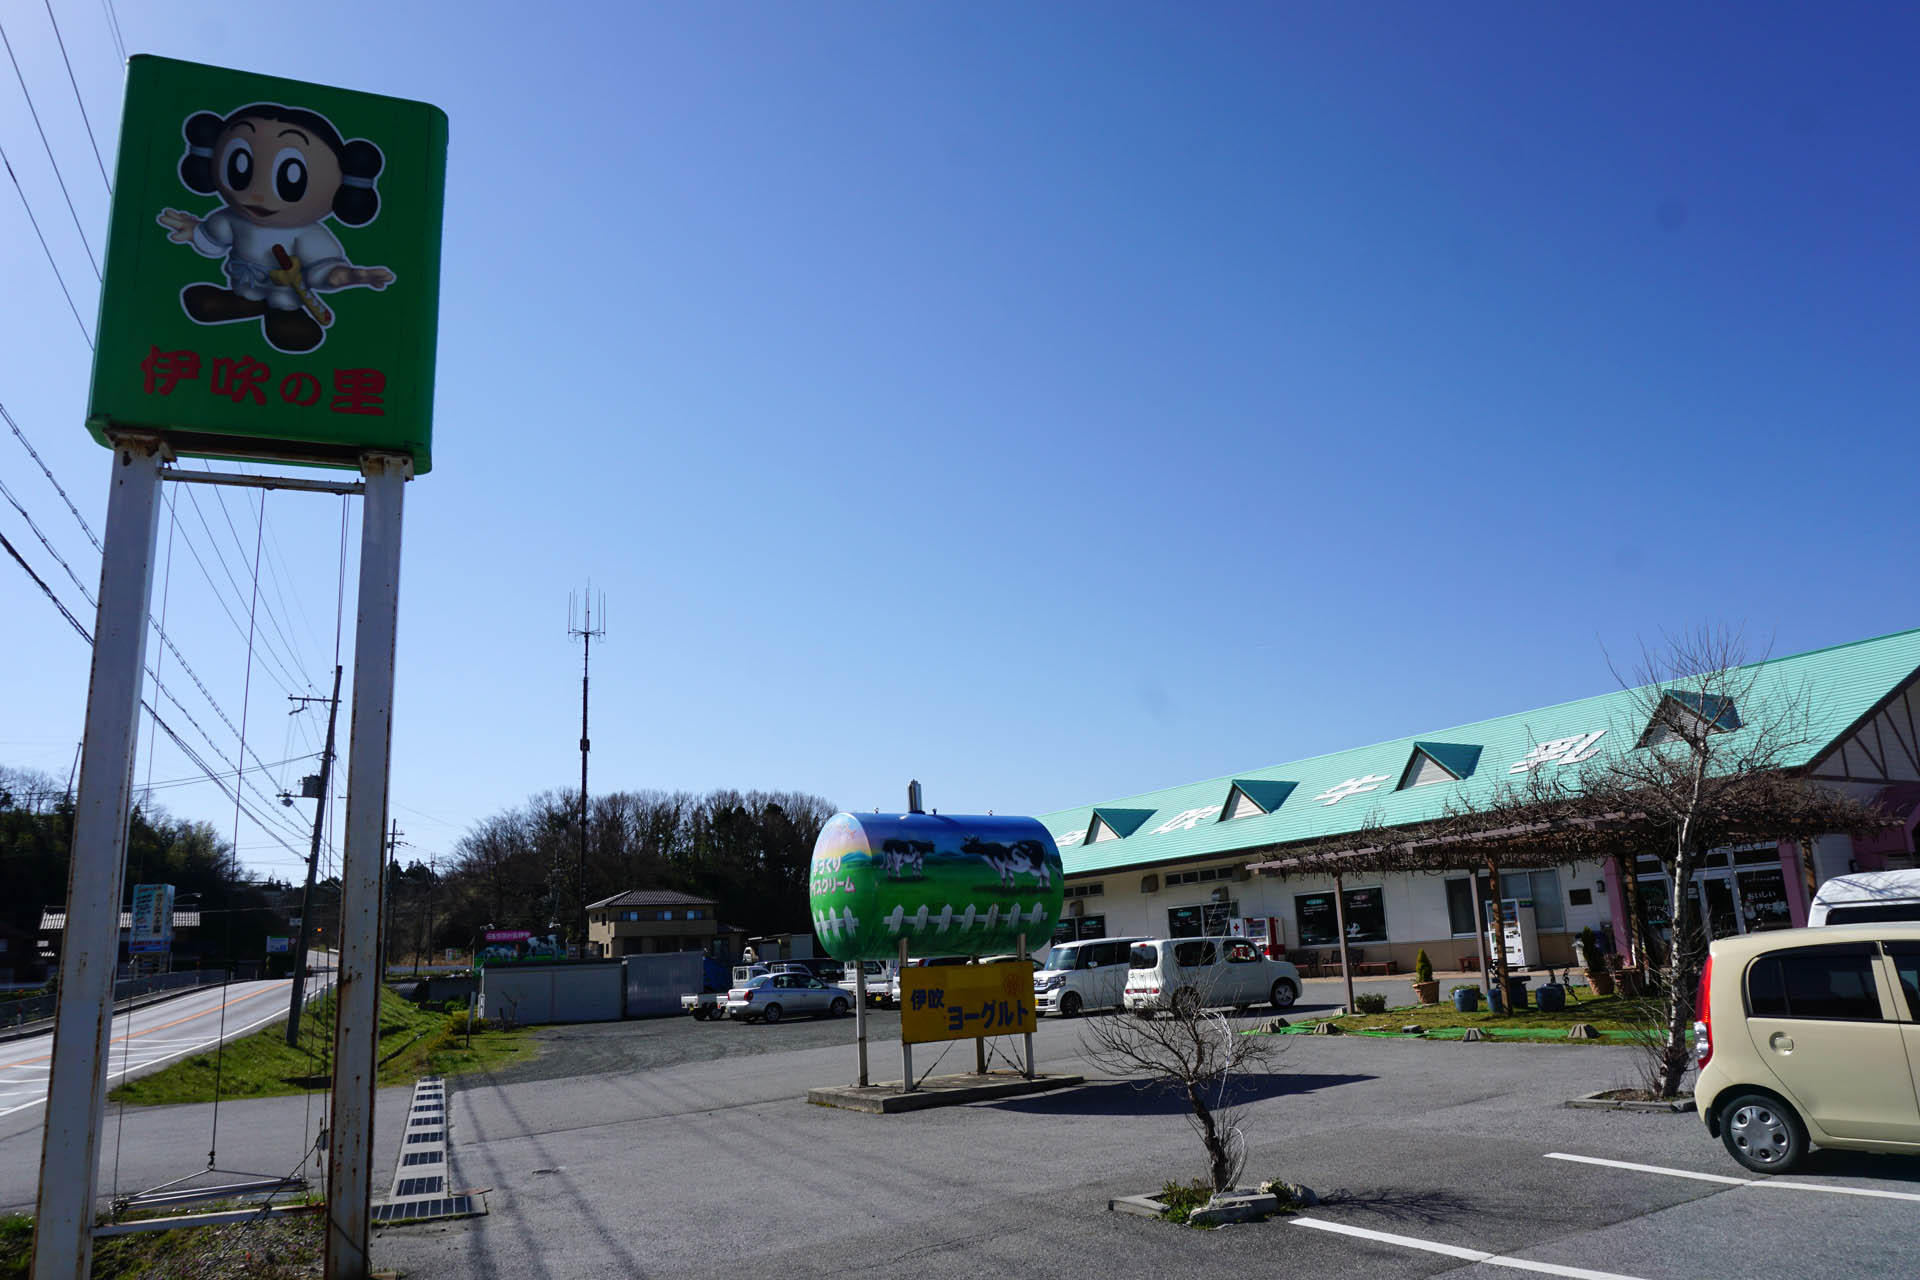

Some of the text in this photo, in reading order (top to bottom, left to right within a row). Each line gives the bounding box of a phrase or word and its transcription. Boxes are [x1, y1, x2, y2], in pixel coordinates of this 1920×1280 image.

[140, 344, 387, 416] 伊吹の里
[911, 988, 945, 1011] 伊吹
[948, 999, 1029, 1031] ヨーグルト
